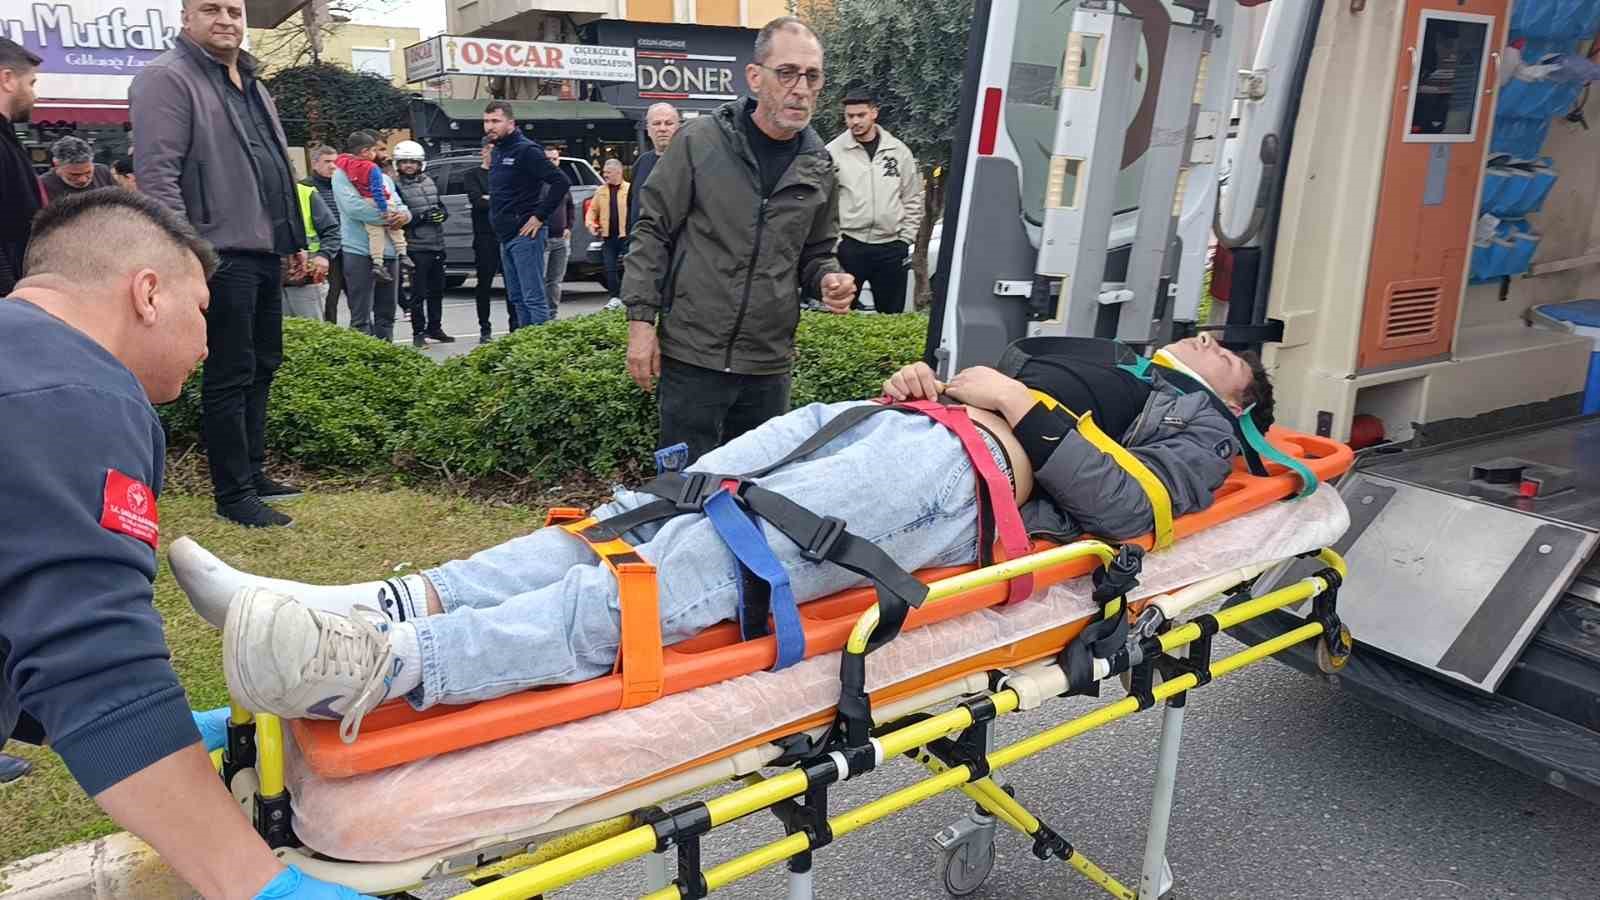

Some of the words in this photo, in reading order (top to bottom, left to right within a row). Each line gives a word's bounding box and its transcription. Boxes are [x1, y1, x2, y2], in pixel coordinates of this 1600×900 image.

[32, 3, 177, 50] Mutfak
[462, 42, 564, 69] OSCAR
[637, 59, 735, 93] DÖNER
